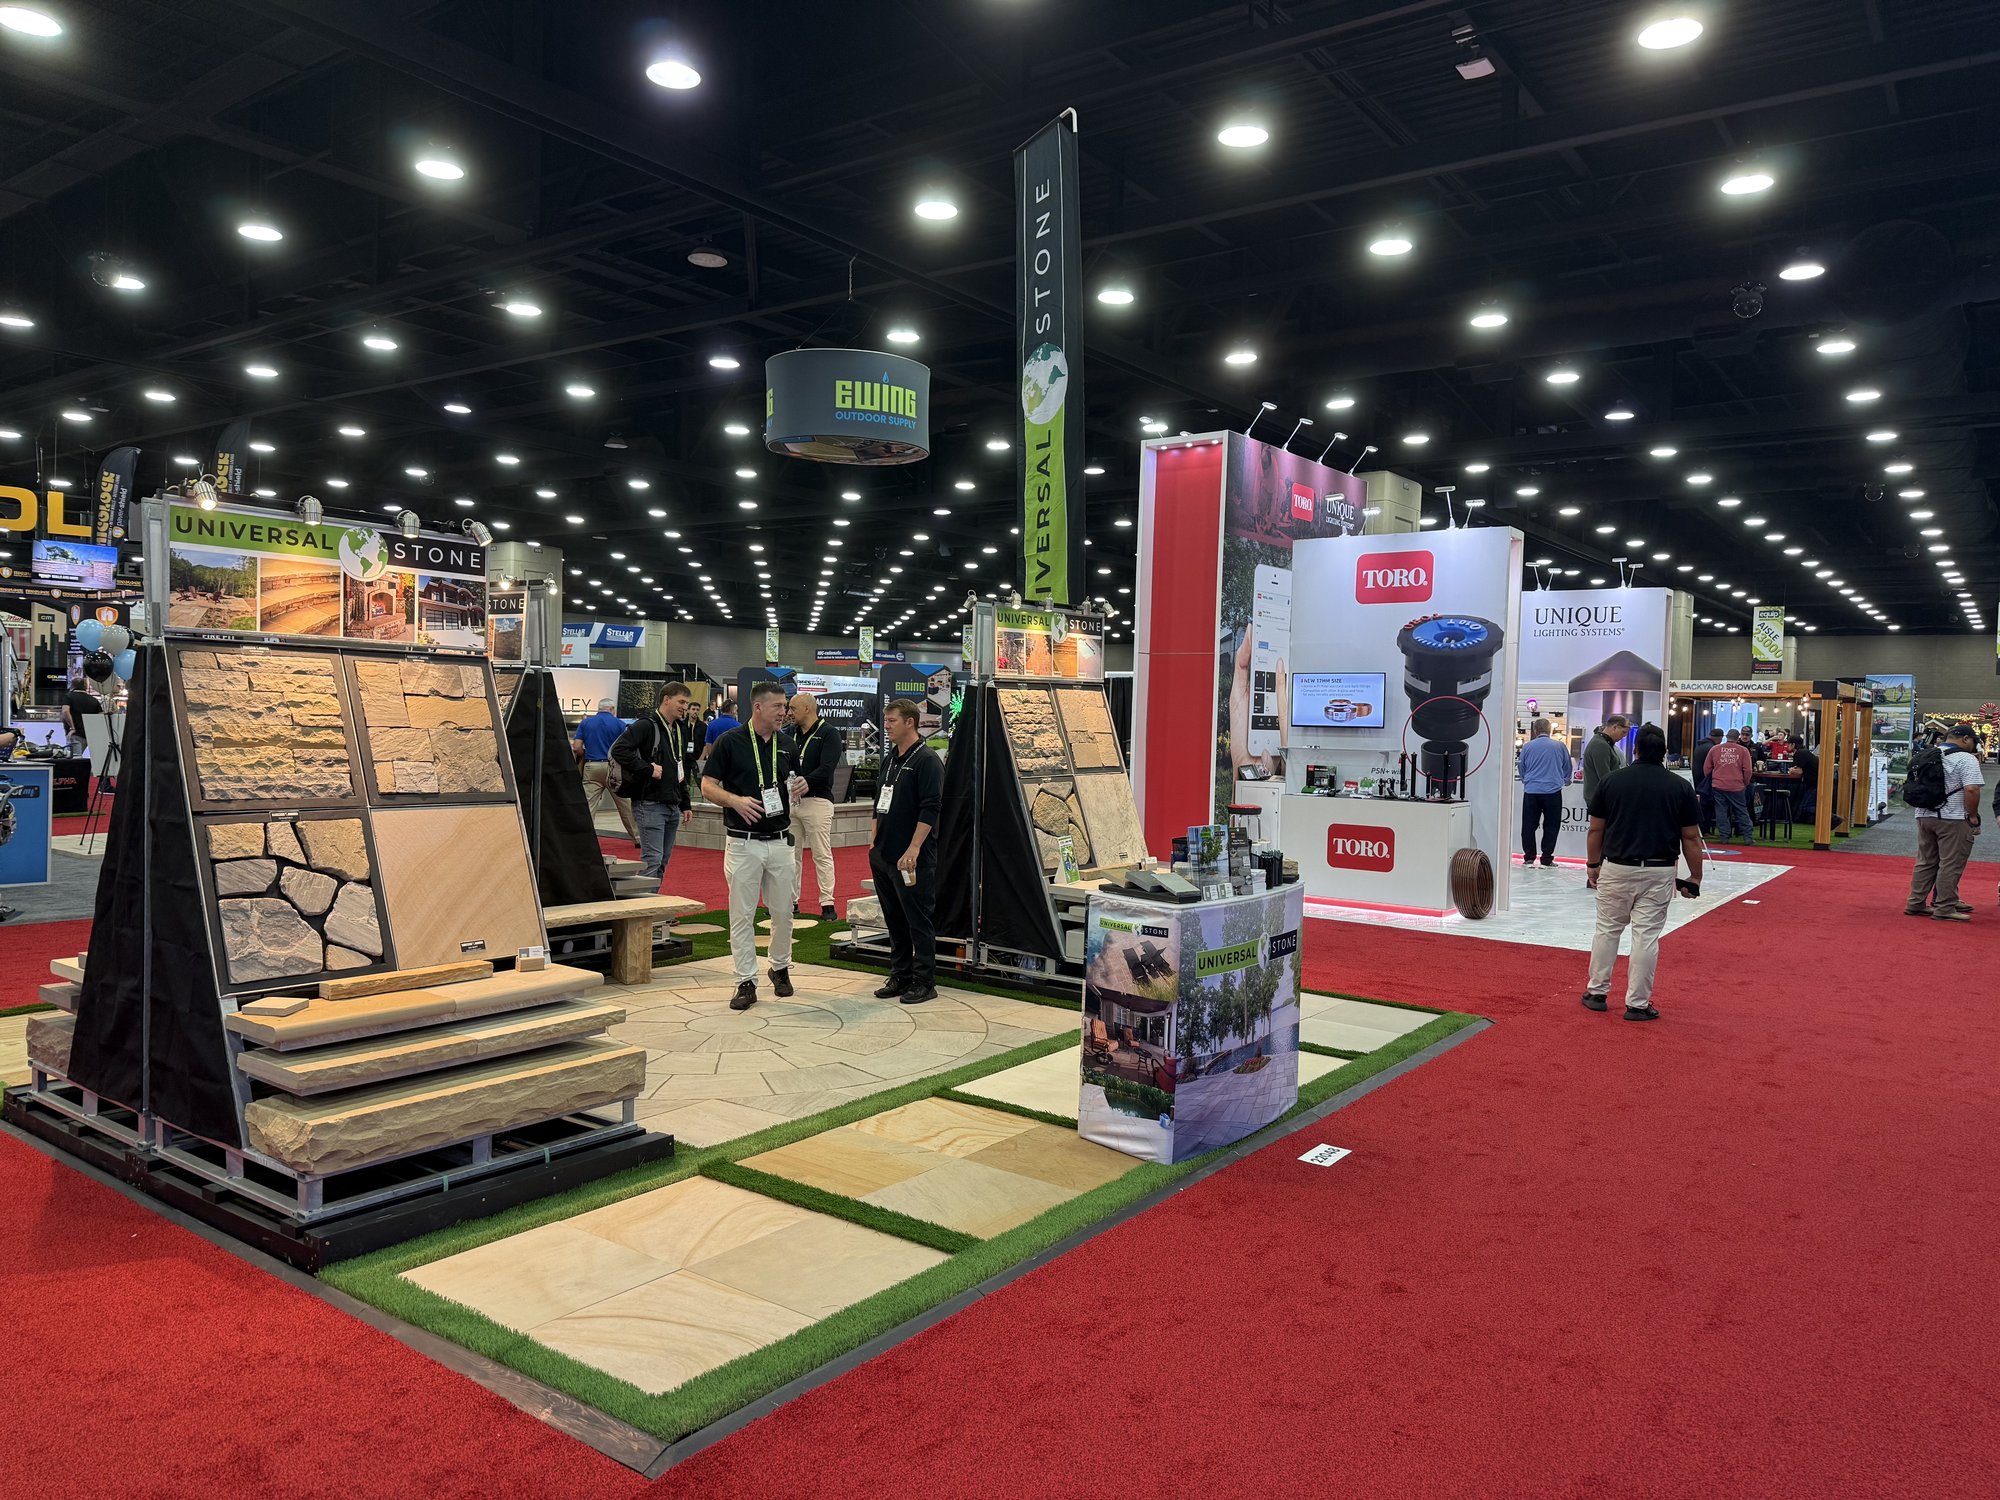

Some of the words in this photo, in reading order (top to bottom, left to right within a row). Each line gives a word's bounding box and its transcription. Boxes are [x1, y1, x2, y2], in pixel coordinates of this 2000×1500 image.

[1035, 178, 1051, 334] STONE
[835, 379, 917, 418] EWING
[835, 411, 886, 425] OUTDOOR
[888, 415, 917, 430] SUPPLY
[1293, 493, 1313, 512] TORO
[1326, 499, 1355, 521] UNIQUE
[175, 515, 334, 551] UNIVERSAL
[393, 542, 481, 569] STONE
[1362, 567, 1427, 589] TORO
[997, 612, 1050, 627] UNIVERSAL
[1069, 619, 1101, 632] STONE
[1535, 606, 1622, 627] UNIQUE
[606, 628, 634, 638] STELLAR
[1533, 628, 1578, 638] LIGHTING
[1757, 622, 1780, 641] AISLE
[1753, 627, 1783, 658] 23000
[895, 681, 925, 692] EWING
[1680, 683, 1724, 691] BACKYARD
[1726, 683, 1774, 691] SHOWCASE
[828, 698, 844, 707] JUST
[844, 699, 864, 708] ABOUT
[818, 708, 853, 718] ANYTHING
[1371, 767, 1390, 775] PSN+
[1332, 837, 1390, 859] TORO
[1100, 919, 1132, 931] UNIVERSAL
[1144, 927, 1168, 936] STONE
[1198, 945, 1257, 971] UNIVERSAL
[1272, 934, 1297, 953] STONE
